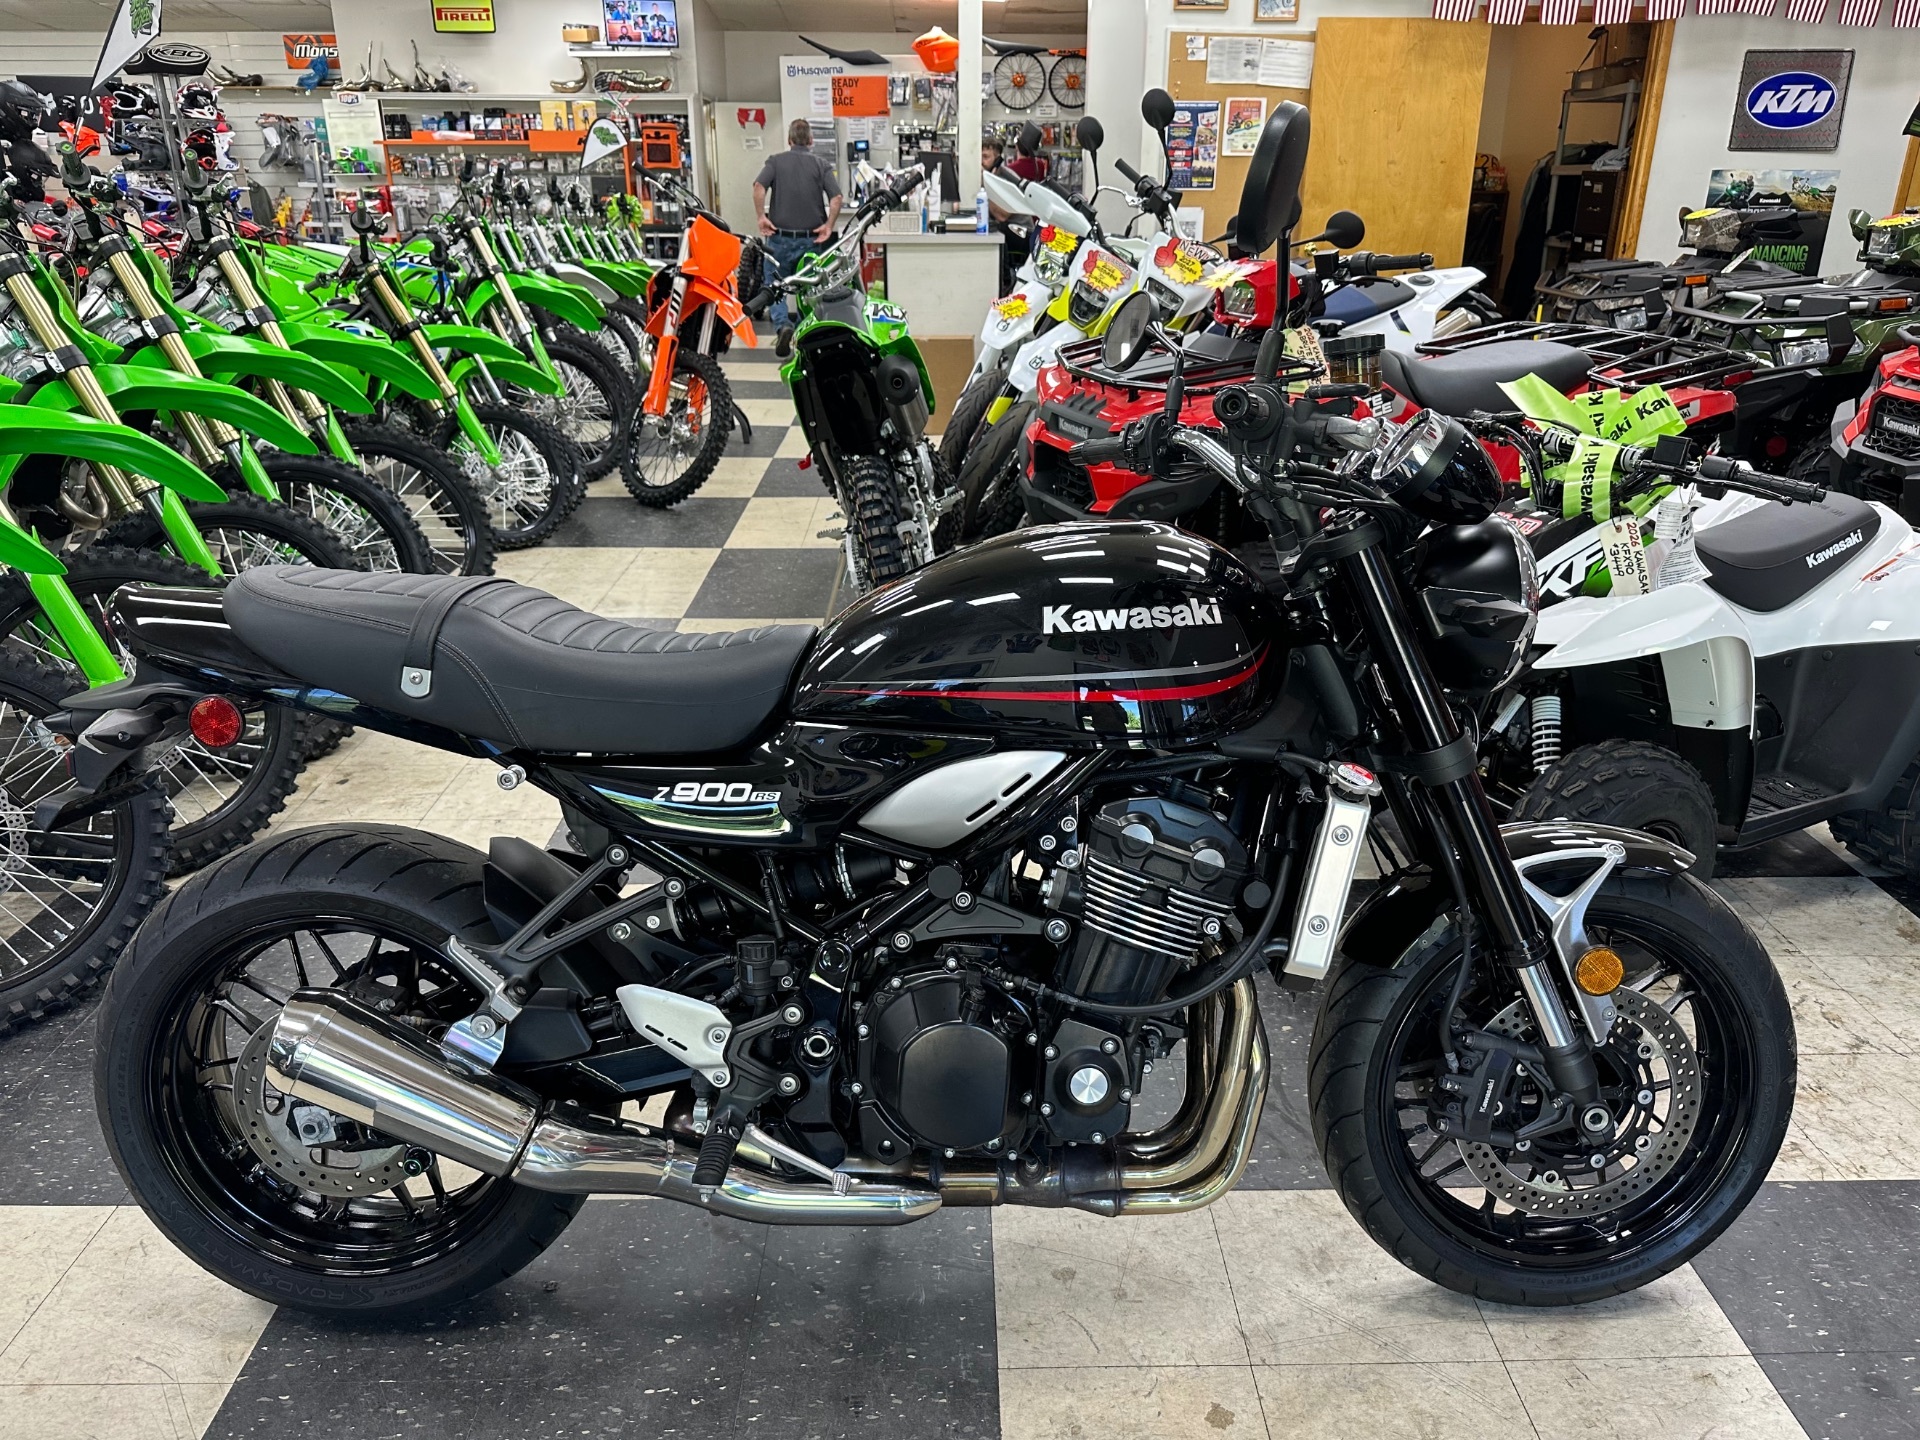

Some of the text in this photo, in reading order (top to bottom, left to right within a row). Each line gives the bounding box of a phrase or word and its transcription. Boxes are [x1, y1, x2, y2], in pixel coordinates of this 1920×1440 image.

[436, 8, 490, 21] PIRELLI
[154, 49, 203, 58] KBC
[797, 66, 843, 76] Husqvarna
[832, 79, 859, 88] READY
[340, 95, 357, 103] 100%
[833, 88, 843, 96] TO
[1751, 84, 1833, 113] KTM
[833, 97, 854, 106] RACE
[271, 260, 299, 271] Kawasaki
[872, 304, 907, 320] KLX
[1304, 328, 1316, 344] 2026
[1059, 416, 1088, 440] Kawasaki
[1883, 416, 1920, 436] Kawasaki
[1626, 522, 1640, 547] 2026
[1805, 529, 1863, 569] Kawasaki
[1620, 543, 1634, 575] KFX90
[1043, 597, 1222, 635] Kawasaki
[1479, 1079, 1495, 1113] Kawasaki
[200, 1240, 345, 1301] ROADSMART
